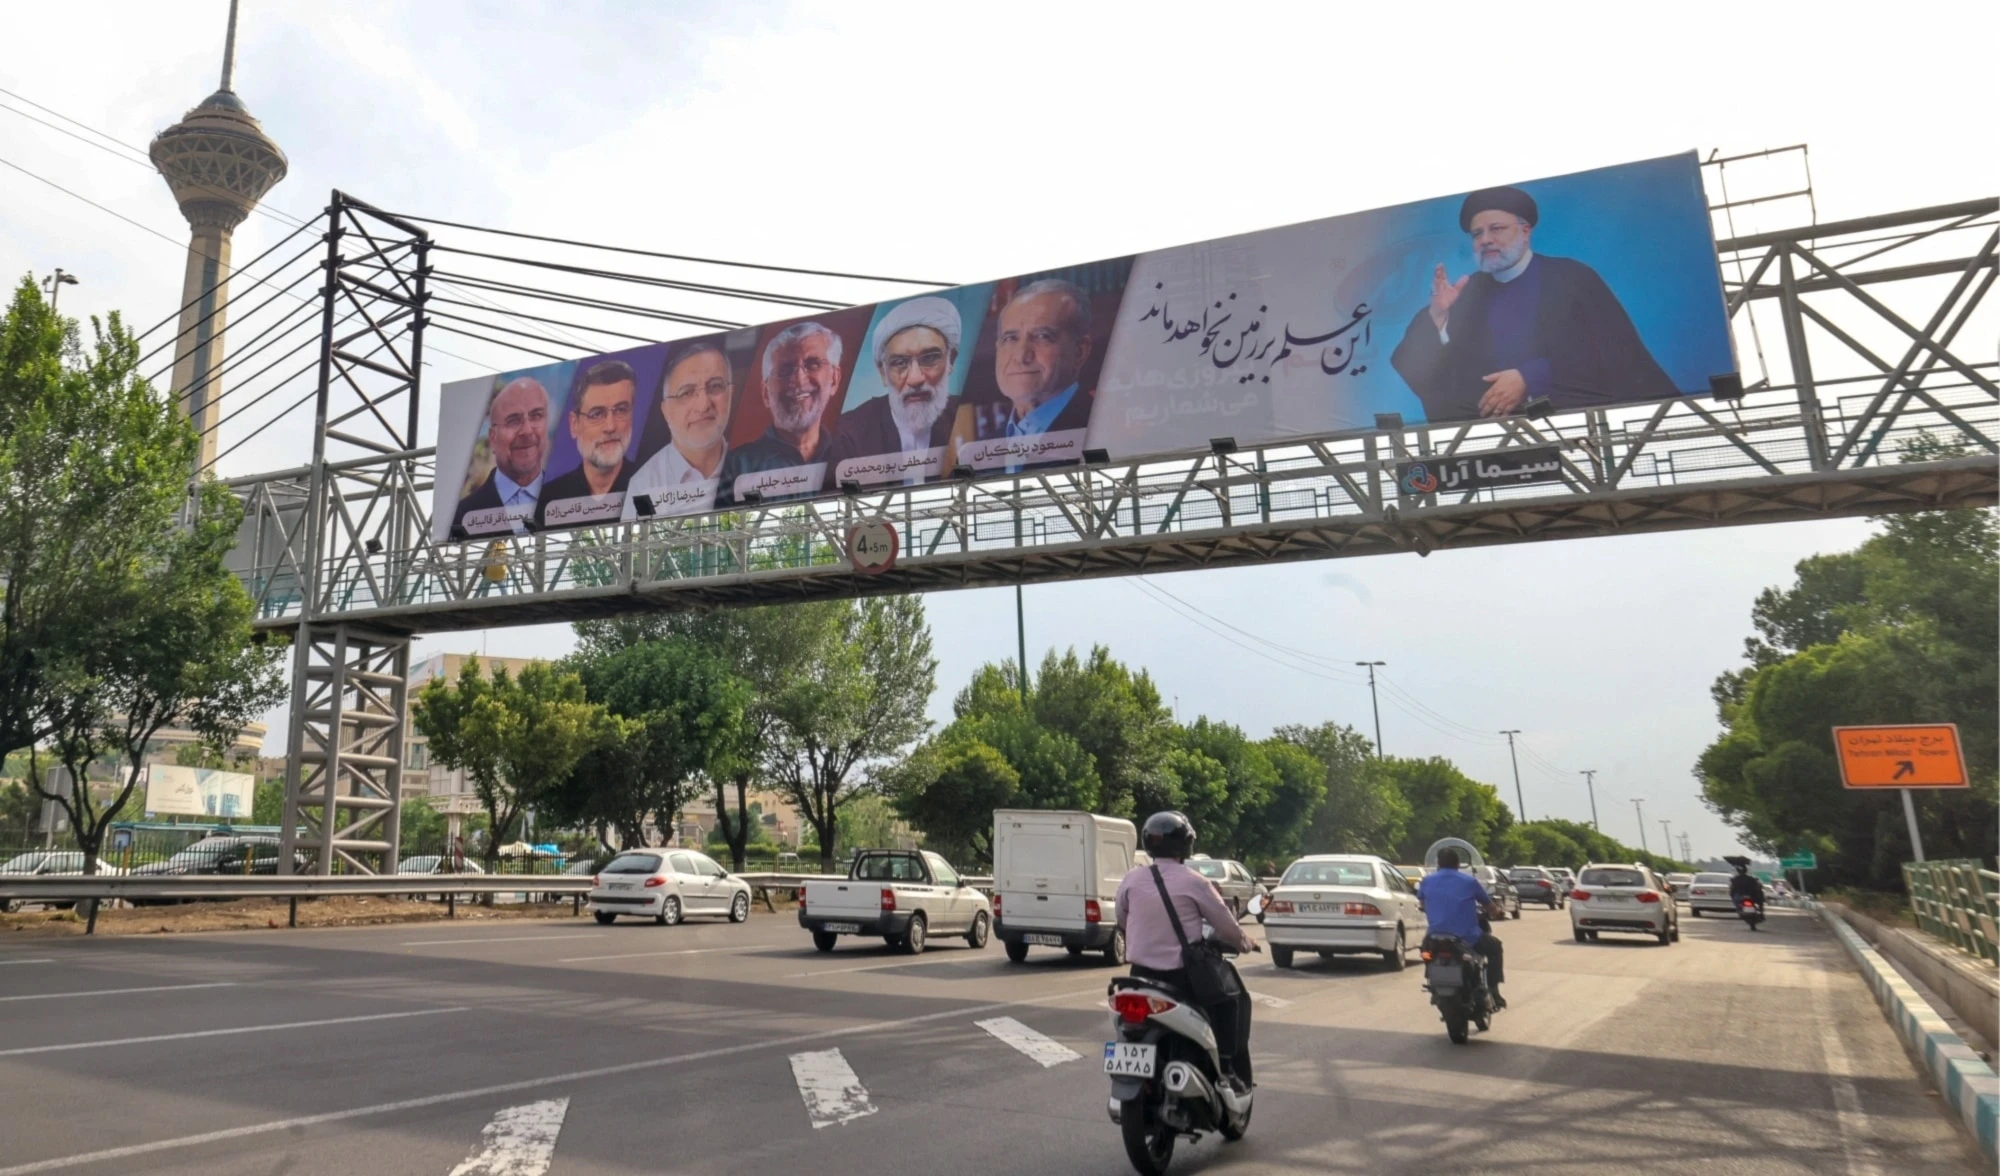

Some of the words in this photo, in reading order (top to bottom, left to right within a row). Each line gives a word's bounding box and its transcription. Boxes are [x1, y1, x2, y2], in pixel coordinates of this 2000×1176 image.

[973, 441, 1031, 462] پزشکیان
[1031, 438, 1075, 456] مسعود
[843, 460, 898, 479] پورمحمدی
[898, 455, 938, 473] مصطفی
[1474, 458, 1560, 480] سیما
[778, 474, 809, 488] سعید
[1438, 459, 1470, 488] آرا
[752, 476, 780, 492] جلیلی
[653, 491, 677, 507] زاکانی
[676, 487, 706, 503] علیرضا
[582, 500, 623, 516] امیرحسین
[467, 514, 492, 528] قالیباف
[1106, 1060, 1151, 1075] ۵۸۳۸۵
